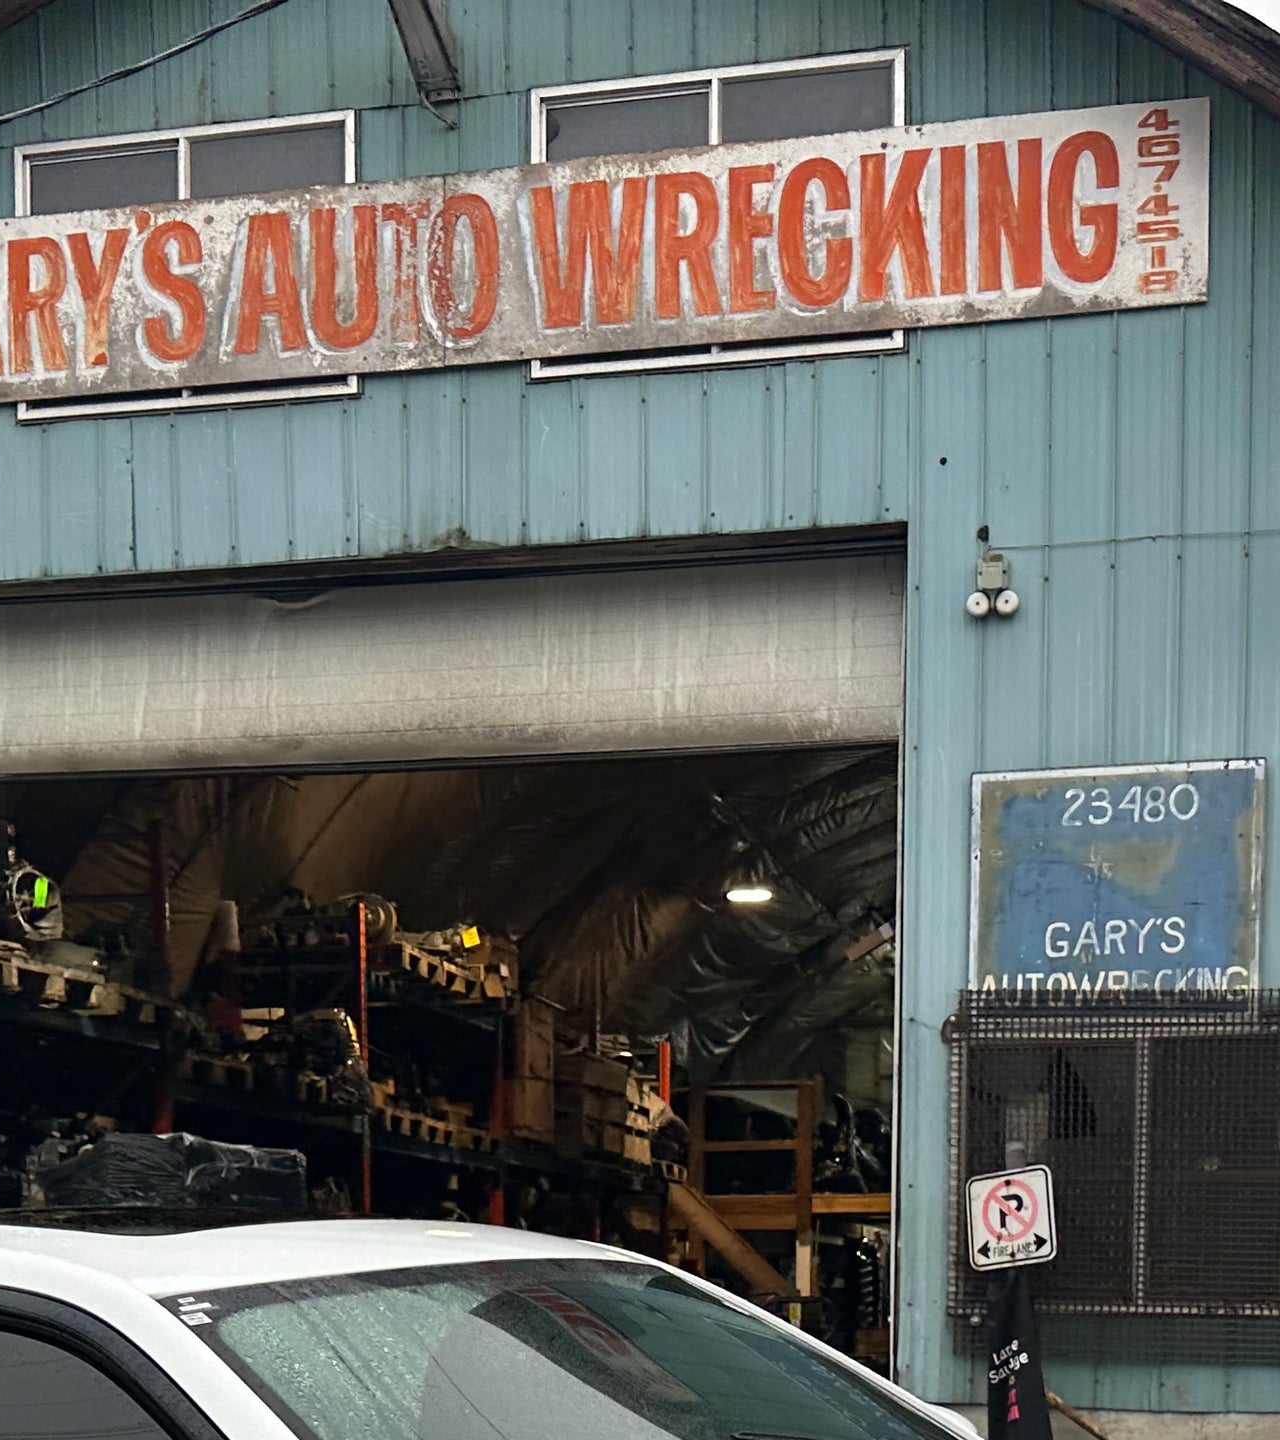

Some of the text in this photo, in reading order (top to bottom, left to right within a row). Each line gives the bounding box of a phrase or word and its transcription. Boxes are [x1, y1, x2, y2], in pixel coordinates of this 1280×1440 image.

[232, 193, 501, 354] AUTO
[530, 130, 1120, 329] WRECKING
[1061, 783, 1200, 827] 23480
[1044, 916, 1187, 959] GARY'S
